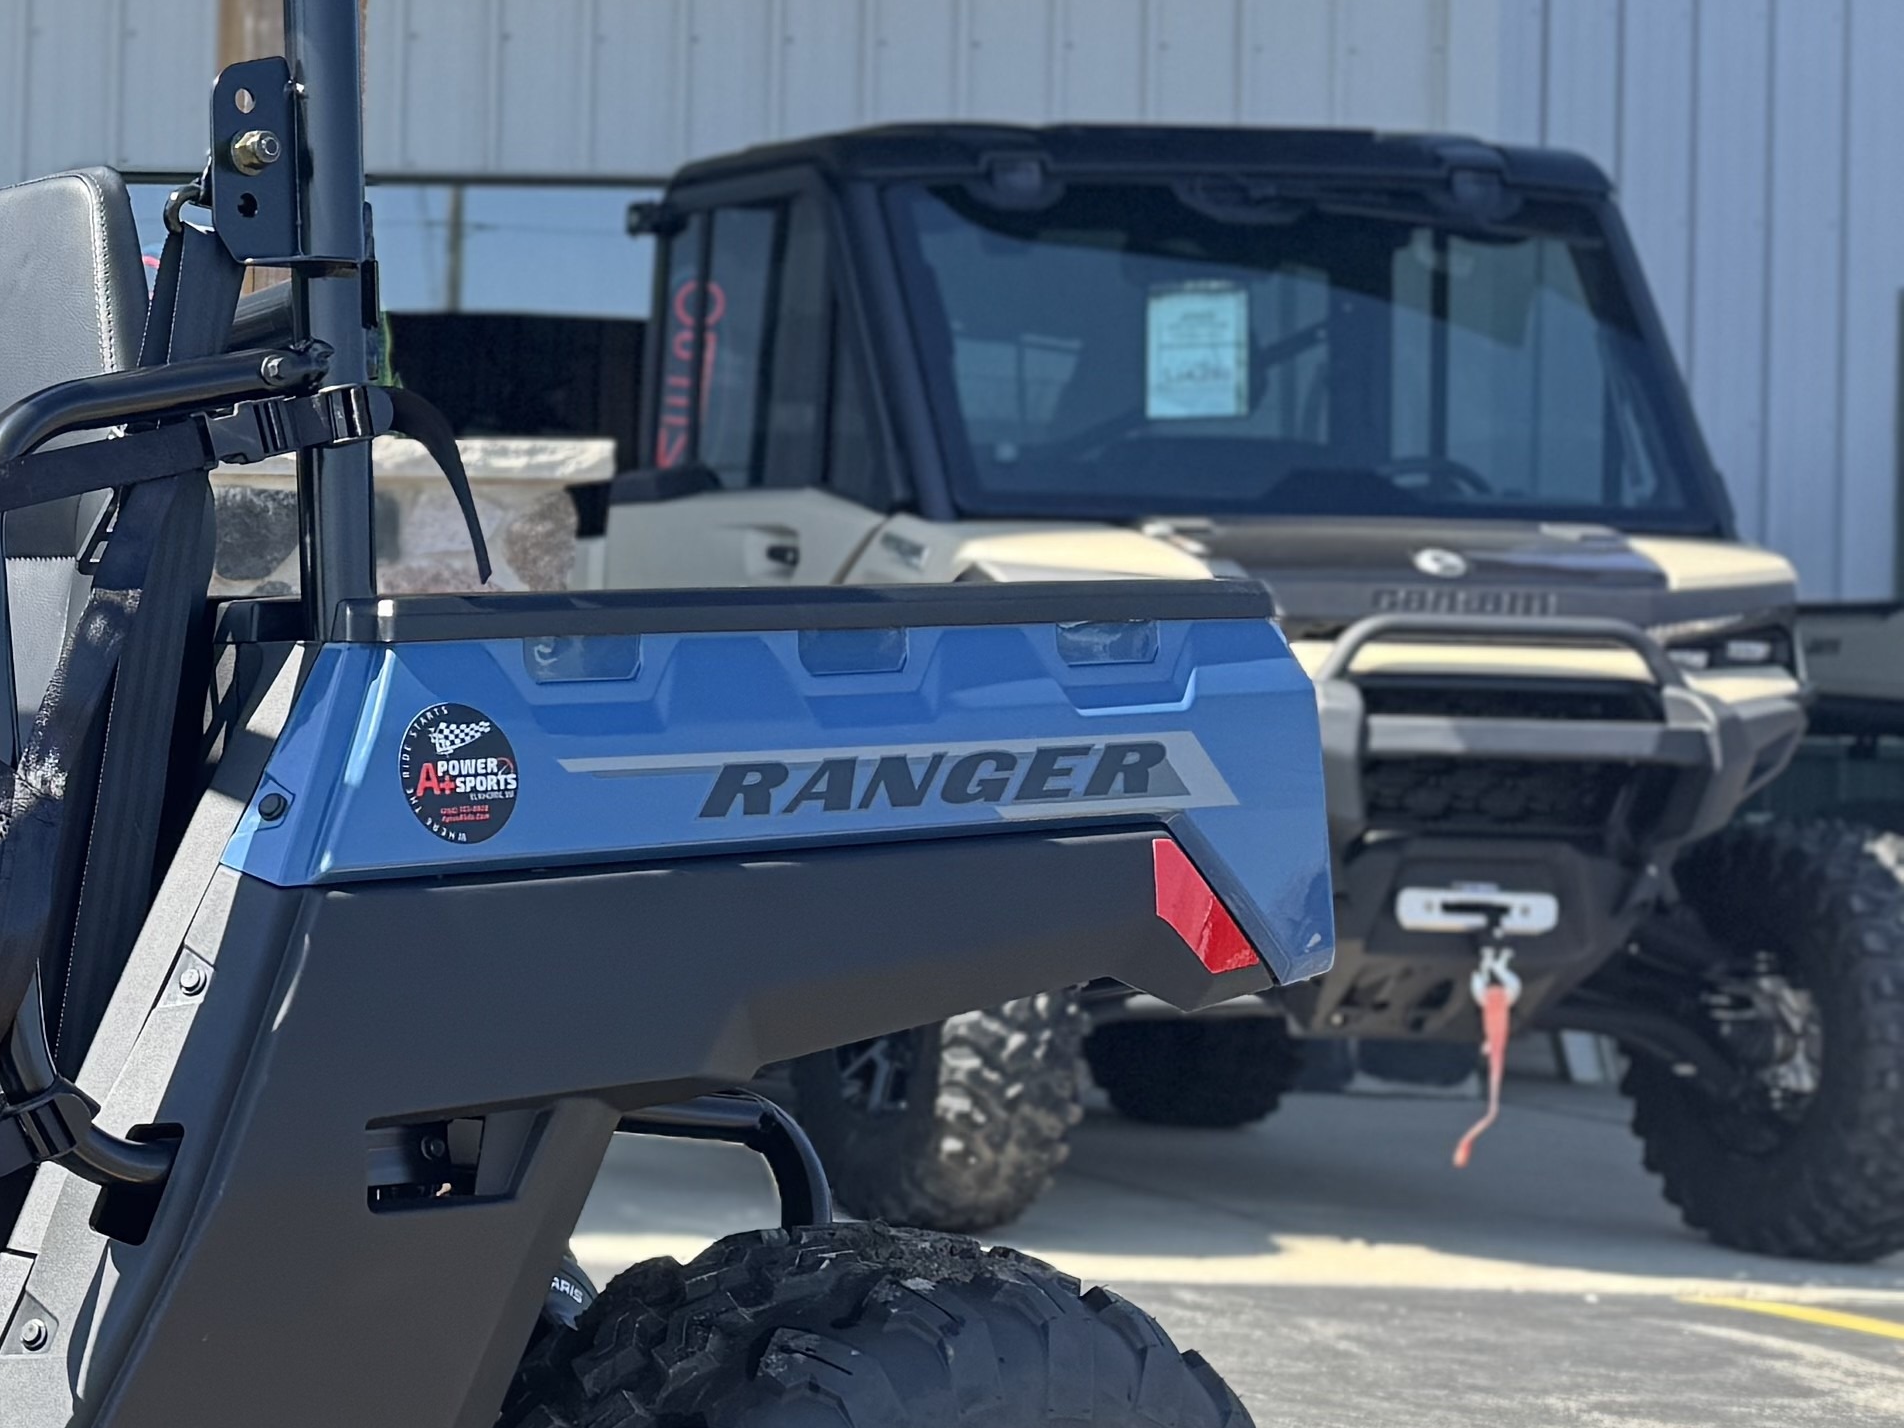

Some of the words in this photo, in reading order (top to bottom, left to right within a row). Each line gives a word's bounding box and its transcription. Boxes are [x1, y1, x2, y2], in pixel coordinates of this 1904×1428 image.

[409, 706, 449, 738] STARTS
[437, 757, 498, 777] POWER
[696, 740, 1170, 819] RANGER
[455, 773, 517, 793] SPORTS
